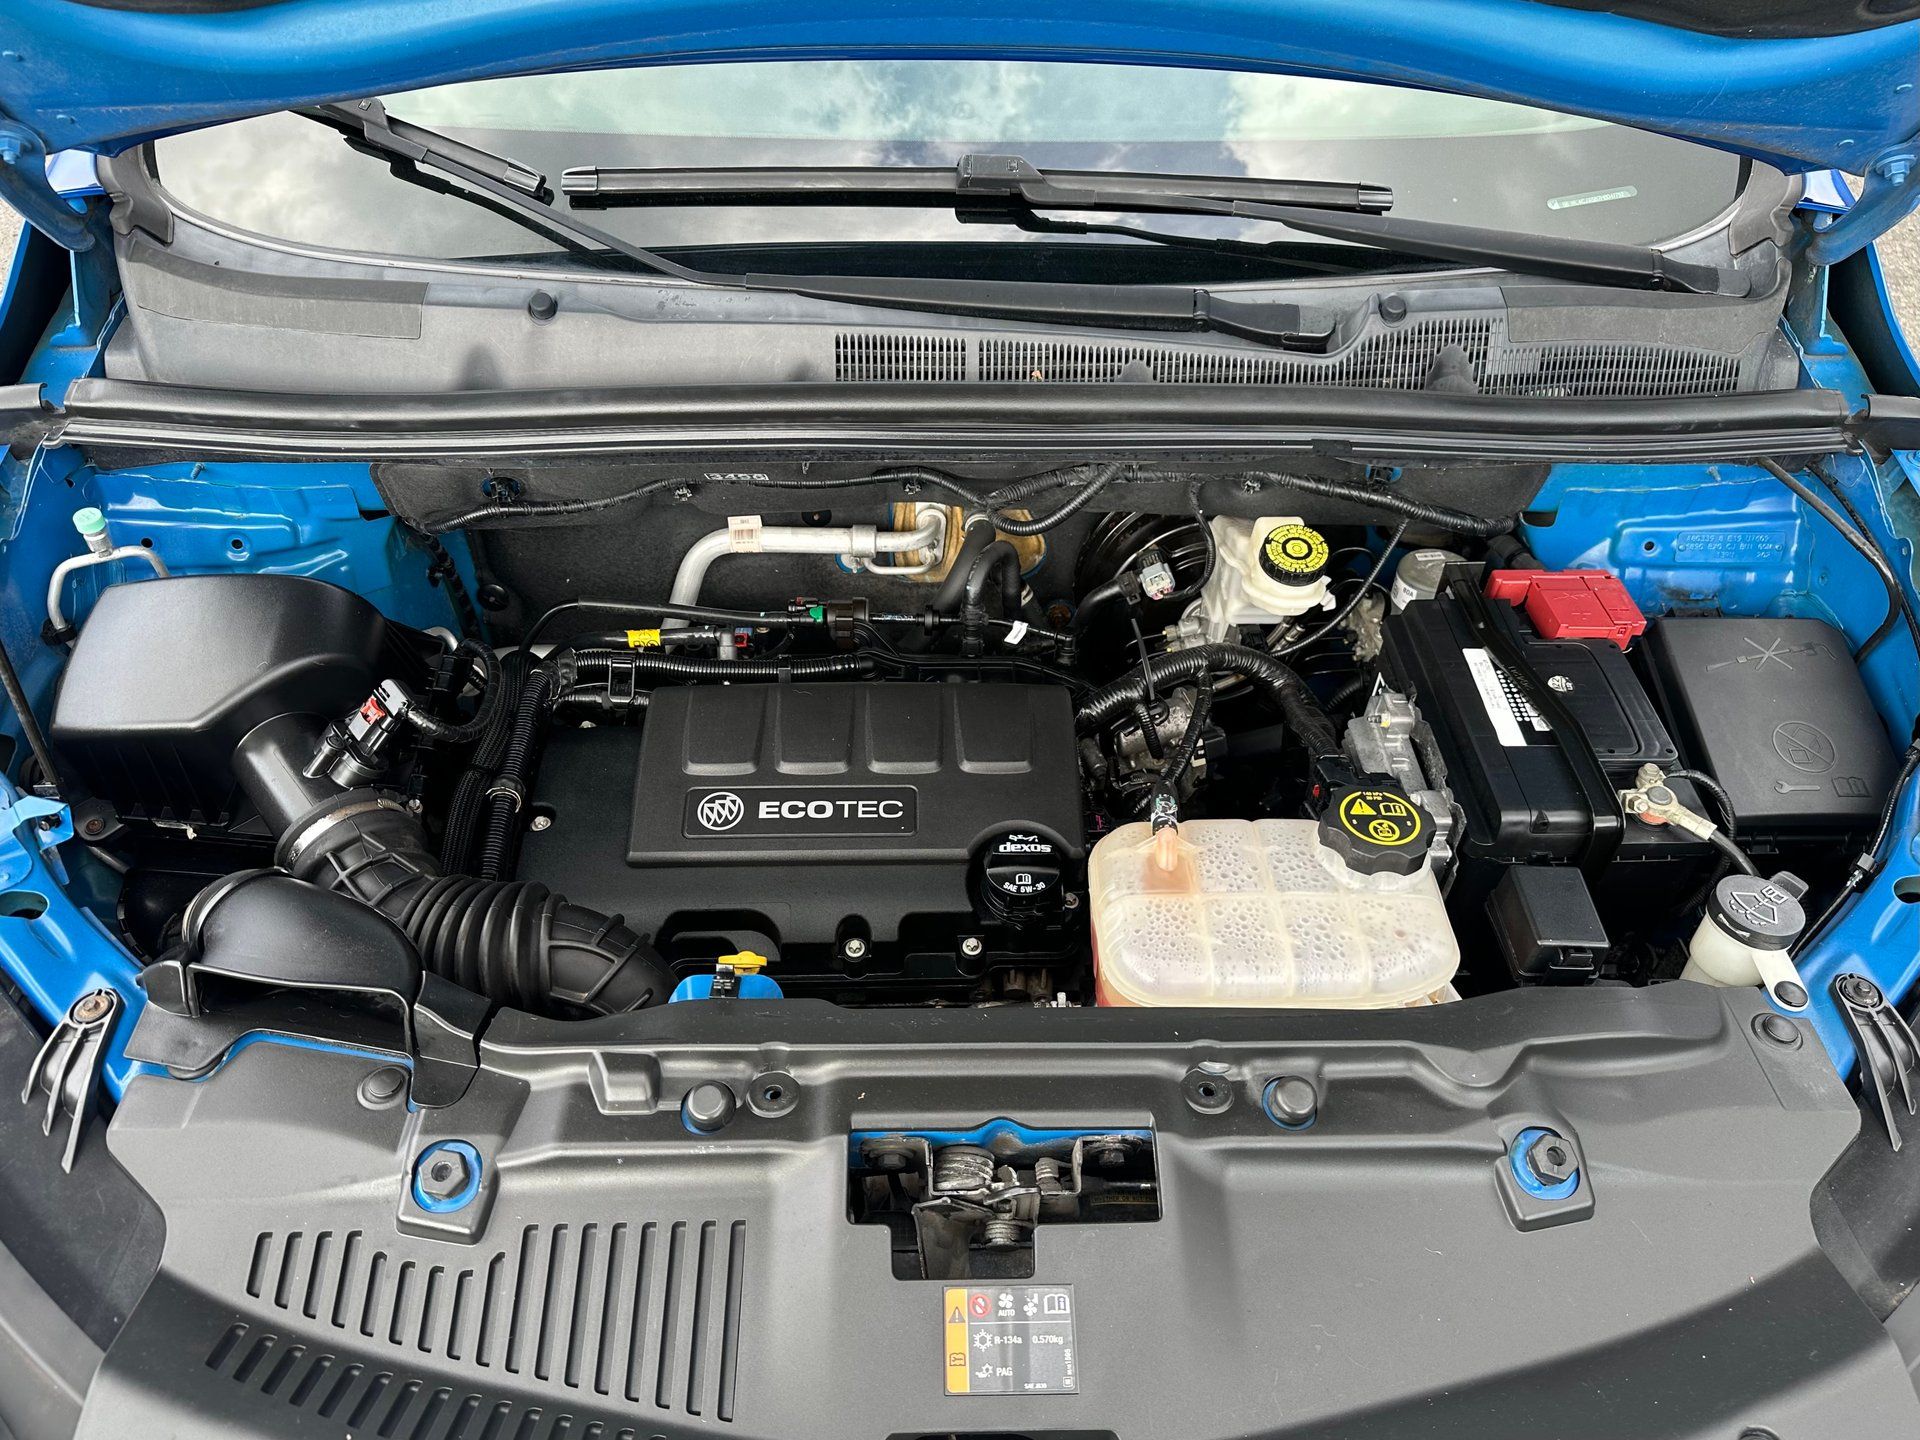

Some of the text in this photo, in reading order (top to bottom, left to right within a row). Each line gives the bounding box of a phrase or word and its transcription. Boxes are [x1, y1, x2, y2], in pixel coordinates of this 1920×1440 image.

[758, 800, 904, 819] ECOTEC
[999, 842, 1053, 853] dexos
[1003, 881, 1046, 893] SAE 5W-30
[998, 1309, 1015, 1317] AUTO
[994, 1335, 1064, 1345] R-134a 0.570kg
[996, 1367, 1013, 1377] PAG
